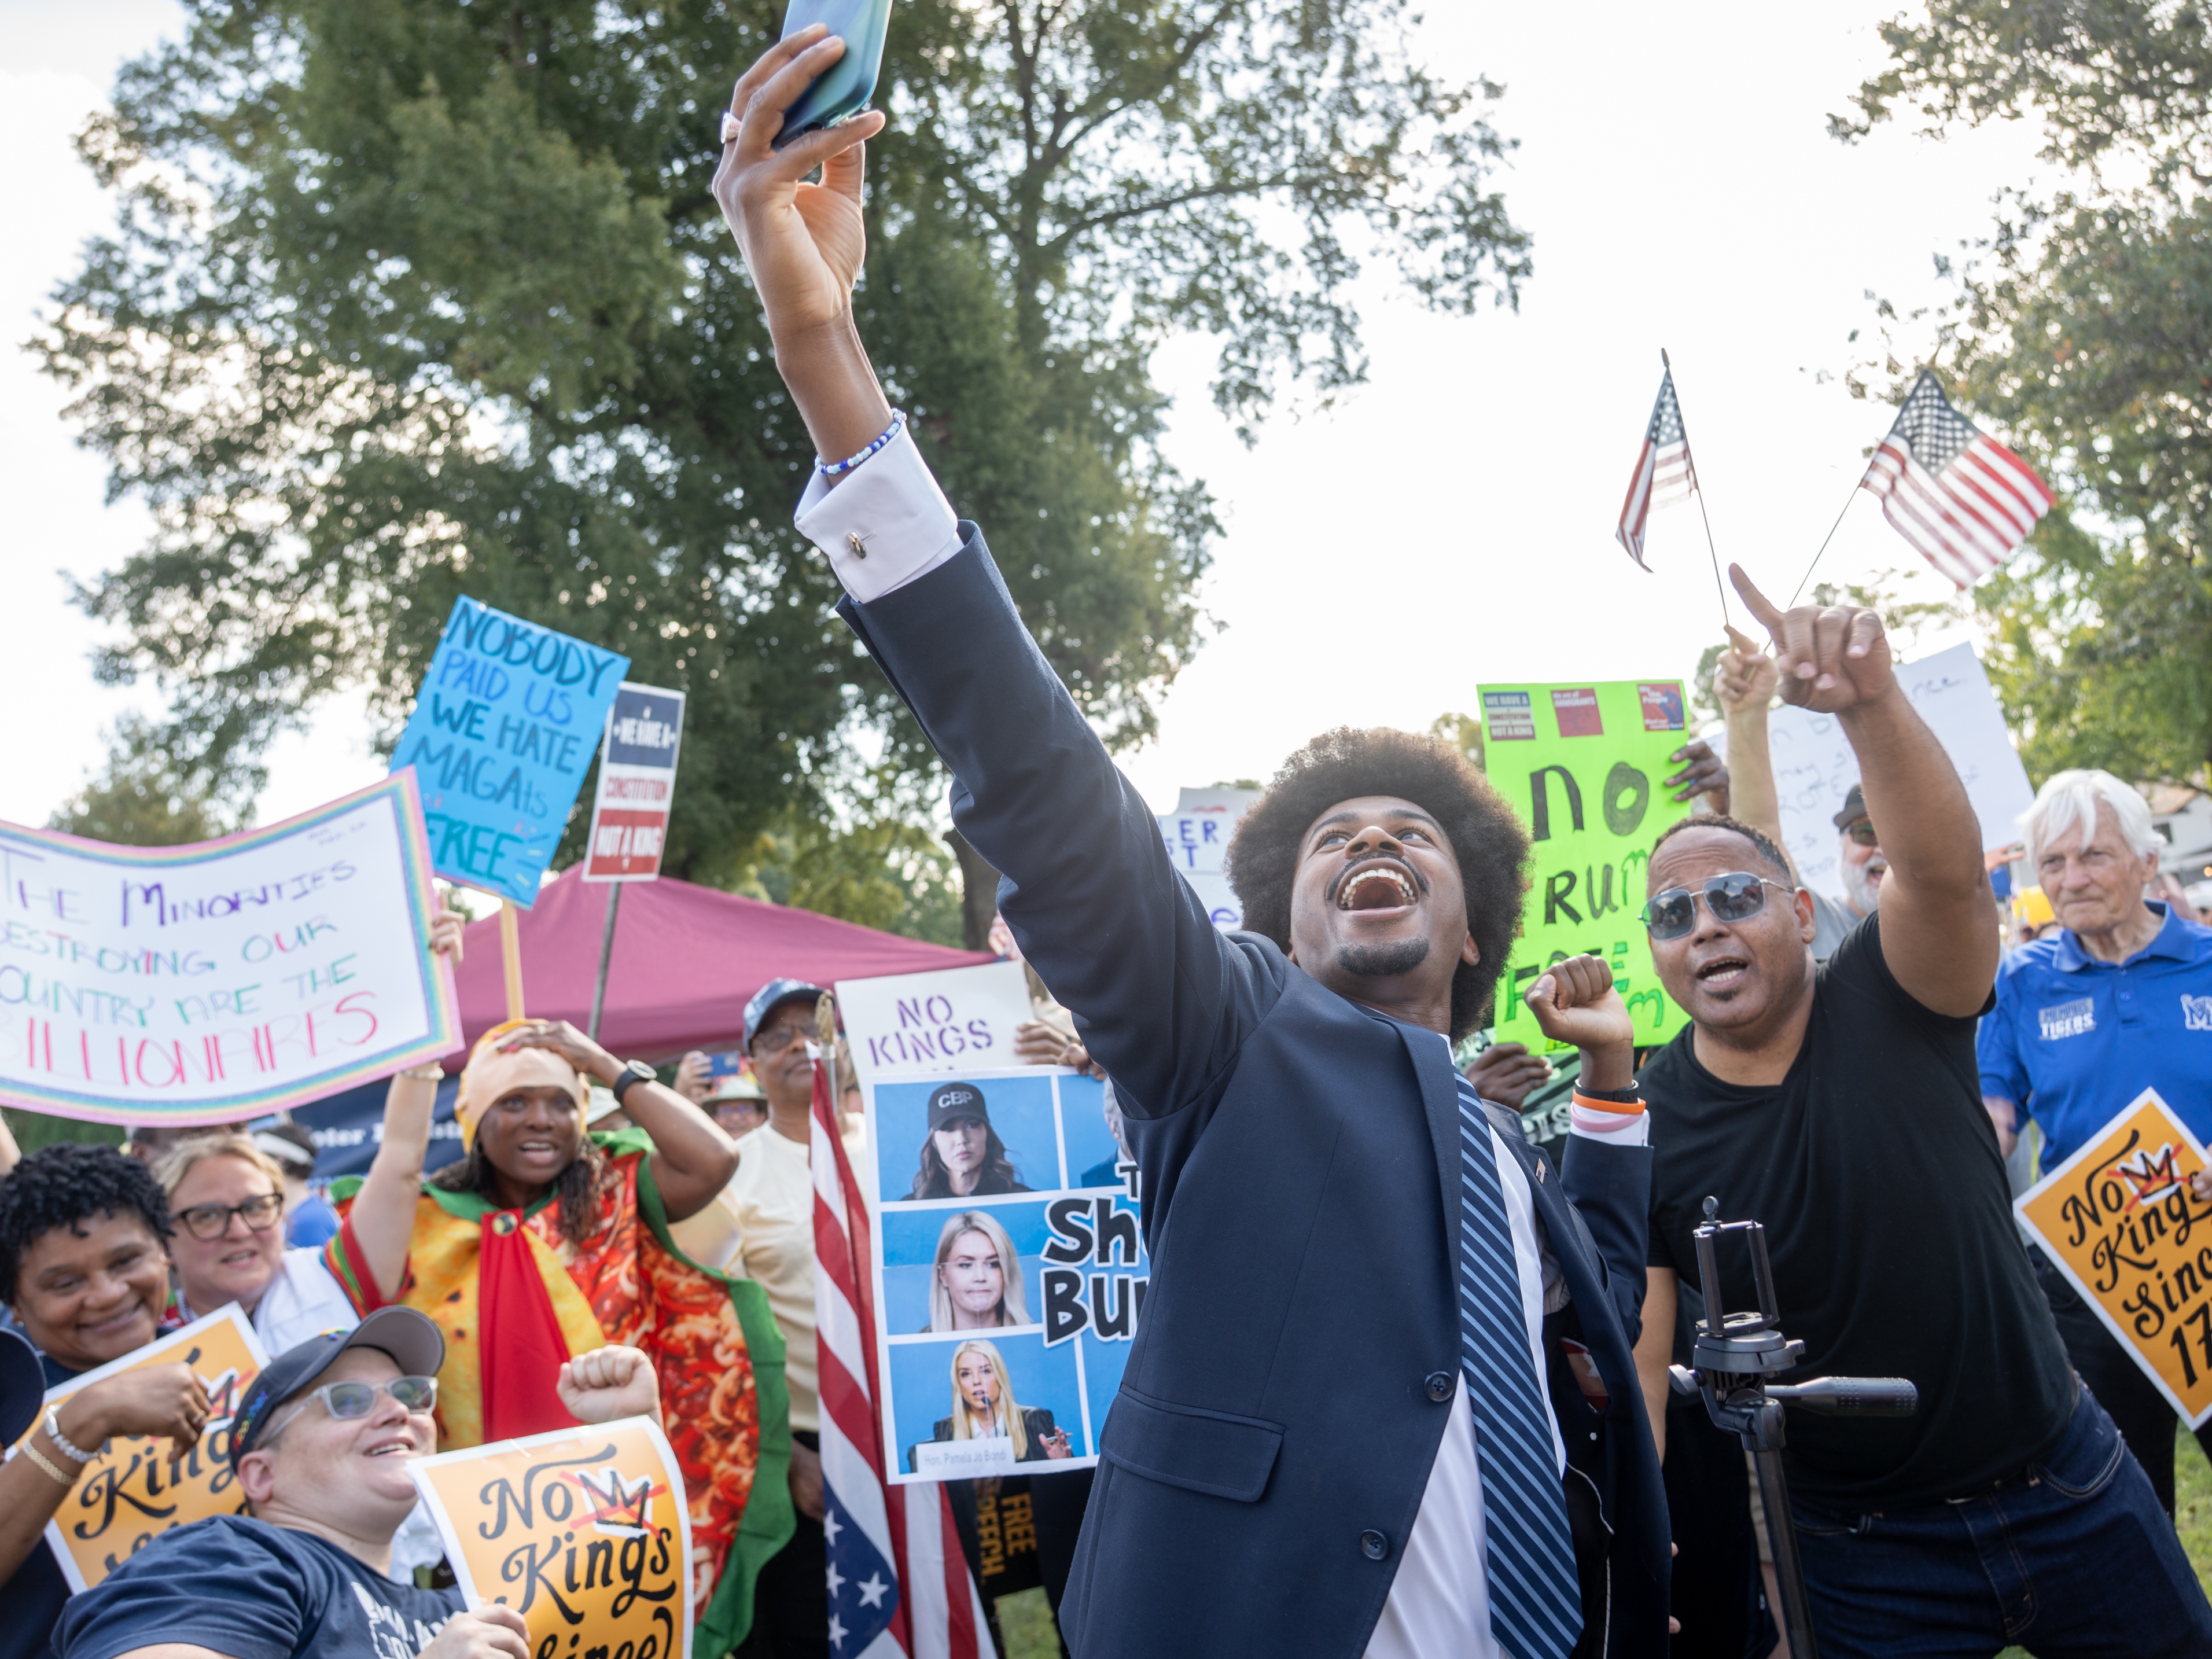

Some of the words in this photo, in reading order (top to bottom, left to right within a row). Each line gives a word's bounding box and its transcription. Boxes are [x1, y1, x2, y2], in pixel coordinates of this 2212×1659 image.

[446, 602, 616, 696] NOBODY
[439, 650, 509, 701] PAID
[525, 681, 573, 725] US
[1500, 696, 1521, 705] HAVE
[1522, 696, 1528, 705] A
[432, 693, 490, 741] WE
[498, 714, 581, 774] HATE
[426, 812, 524, 883] FREE
[122, 860, 358, 926] MINORITIES
[243, 915, 338, 962] OUR
[175, 983, 262, 1025] ARE
[282, 954, 357, 999] THE
[897, 995, 953, 1028] NO
[868, 1020, 993, 1067] KINGS
[938, 1091, 973, 1108] CBP
[2062, 1130, 2139, 1248] No
[479, 1444, 616, 1539] No
[1001, 1492, 1037, 1557] FREE
[495, 1528, 676, 1624] Kings
